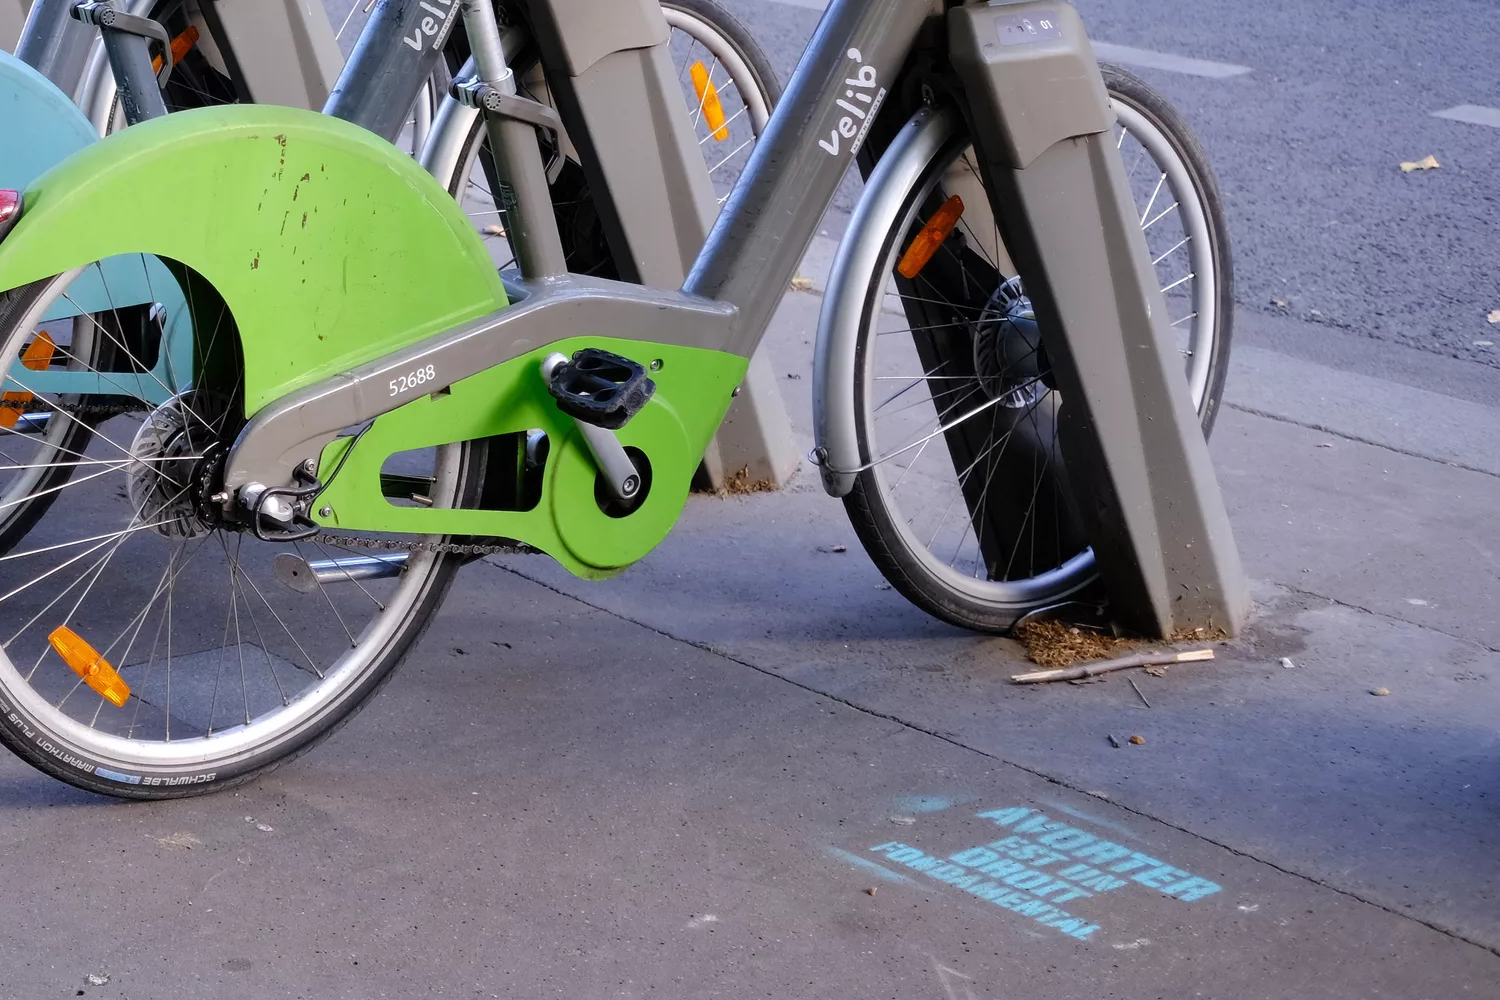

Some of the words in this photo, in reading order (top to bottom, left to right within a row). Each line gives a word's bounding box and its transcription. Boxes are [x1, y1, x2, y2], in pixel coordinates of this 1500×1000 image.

[1040, 19, 1053, 30] 01
[389, 364, 436, 397] 52688
[7, 713, 36, 739] PLUS
[35, 737, 95, 774] MARATHON
[142, 772, 217, 786] SCHWALBE
[974, 805, 1223, 901] AVORTER
[989, 836, 1069, 867] EST
[948, 846, 1094, 904] DROIT
